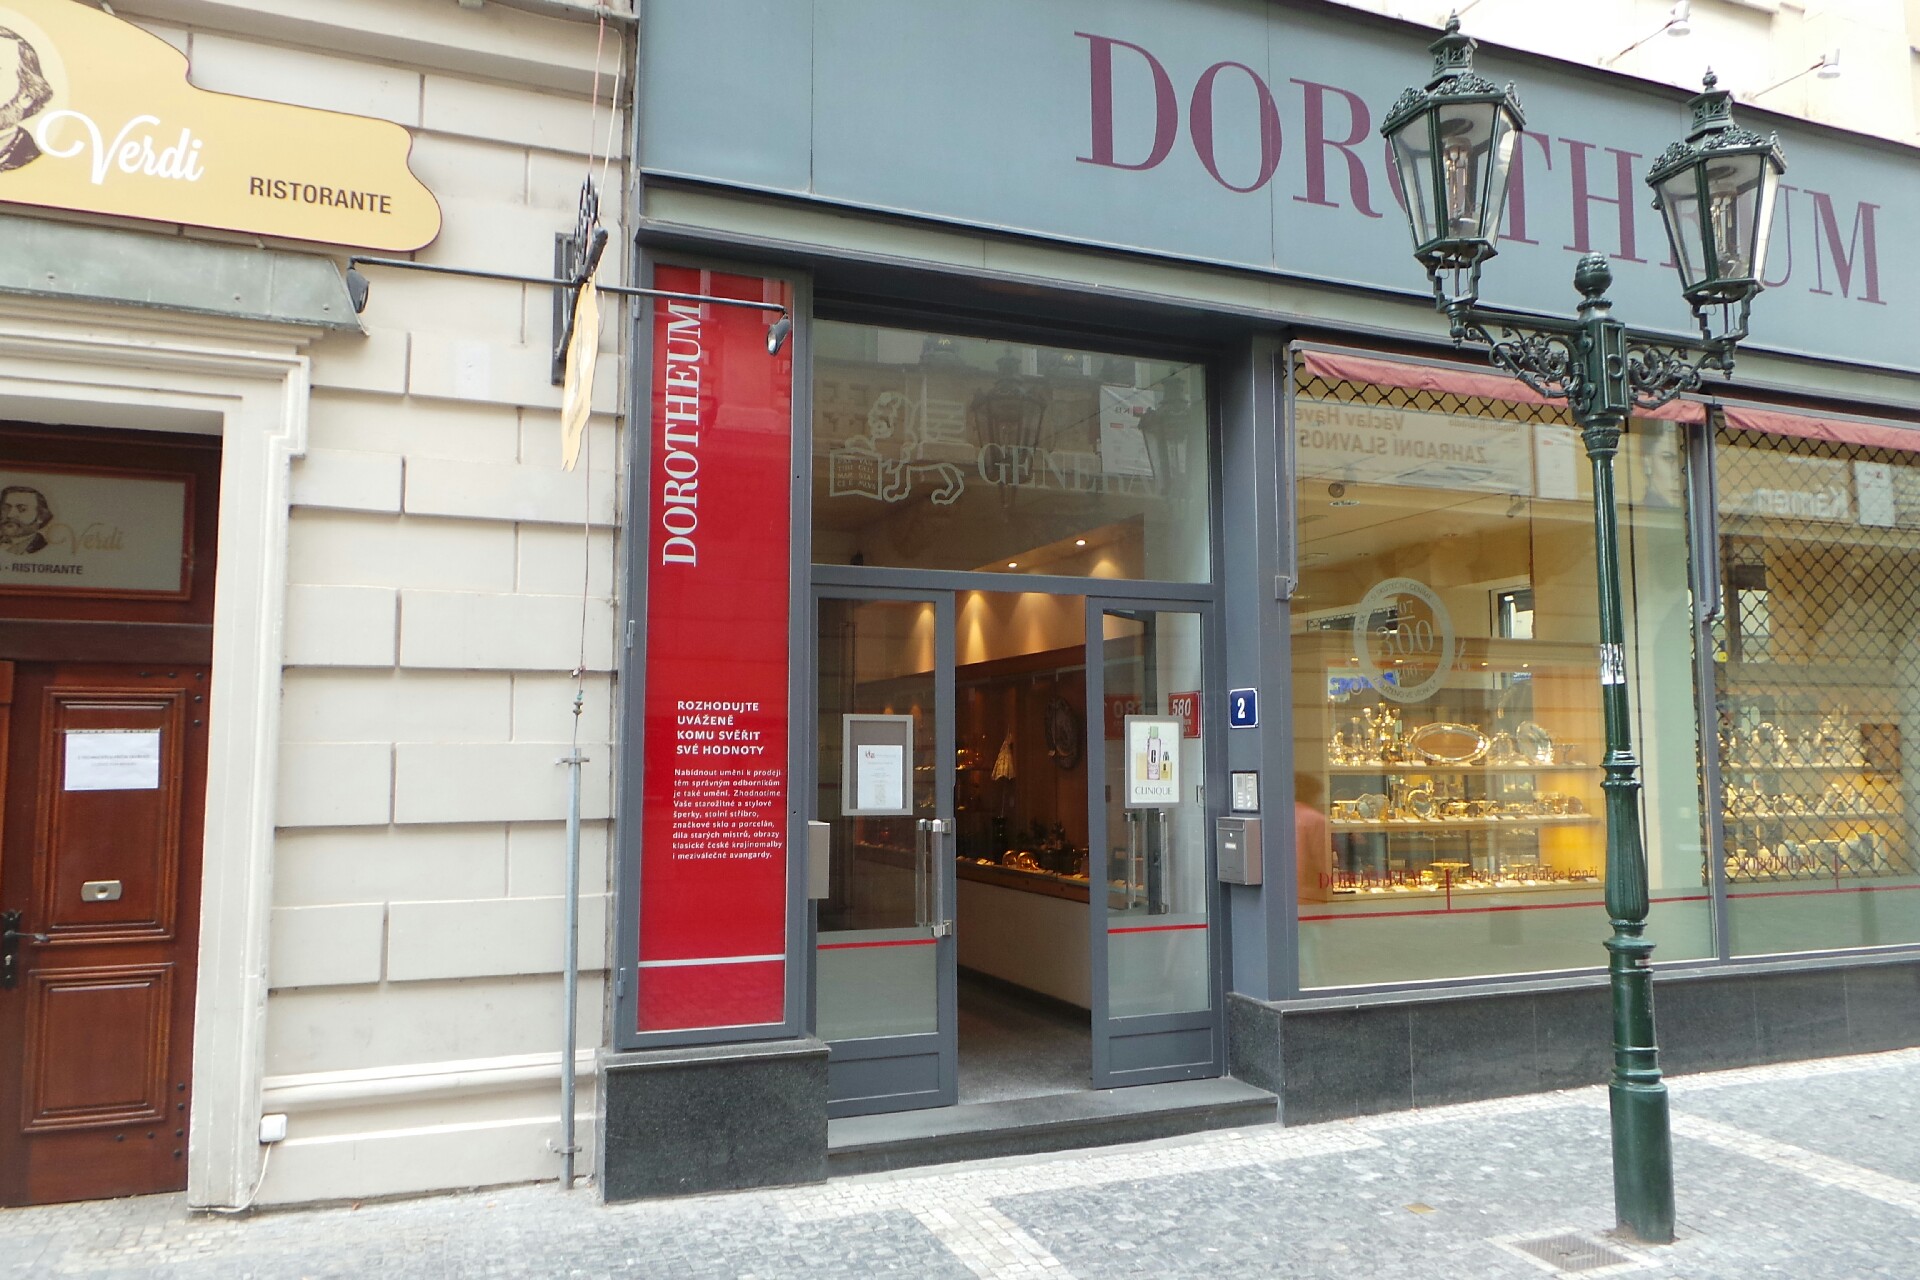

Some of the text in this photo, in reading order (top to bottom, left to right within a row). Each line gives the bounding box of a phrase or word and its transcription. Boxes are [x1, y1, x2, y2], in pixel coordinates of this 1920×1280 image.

[36, 109, 205, 185] Verdi
[1073, 30, 1888, 306] DORTHUM
[249, 176, 392, 215] RISTORANTE
[662, 299, 701, 568] DOROTHEUM
[11, 562, 83, 575] RISTORANTE
[677, 700, 759, 713] ROZHODUJTE
[1172, 698, 1191, 717] 580
[1237, 697, 1246, 719] 2
[677, 714, 734, 726] UVÁŽENĚ
[677, 729, 761, 741] KOMU SVĚŘIT
[676, 743, 764, 755] SVÉ HODNOTY
[753, 769, 781, 778] prodeji
[691, 779, 730, 788] správným
[673, 790, 681, 798] je
[1135, 786, 1173, 796] CLINIQUE
[694, 799, 735, 807] starožitné
[744, 799, 772, 808] stylové
[673, 810, 702, 819] šperky,
[704, 810, 728, 818] stolní
[672, 821, 710, 829] značkové
[712, 820, 729, 828] sklo
[690, 831, 720, 840] starých
[753, 831, 780, 839] obrazy
[707, 841, 729, 849] české
[731, 840, 782, 850] krajinomalby
